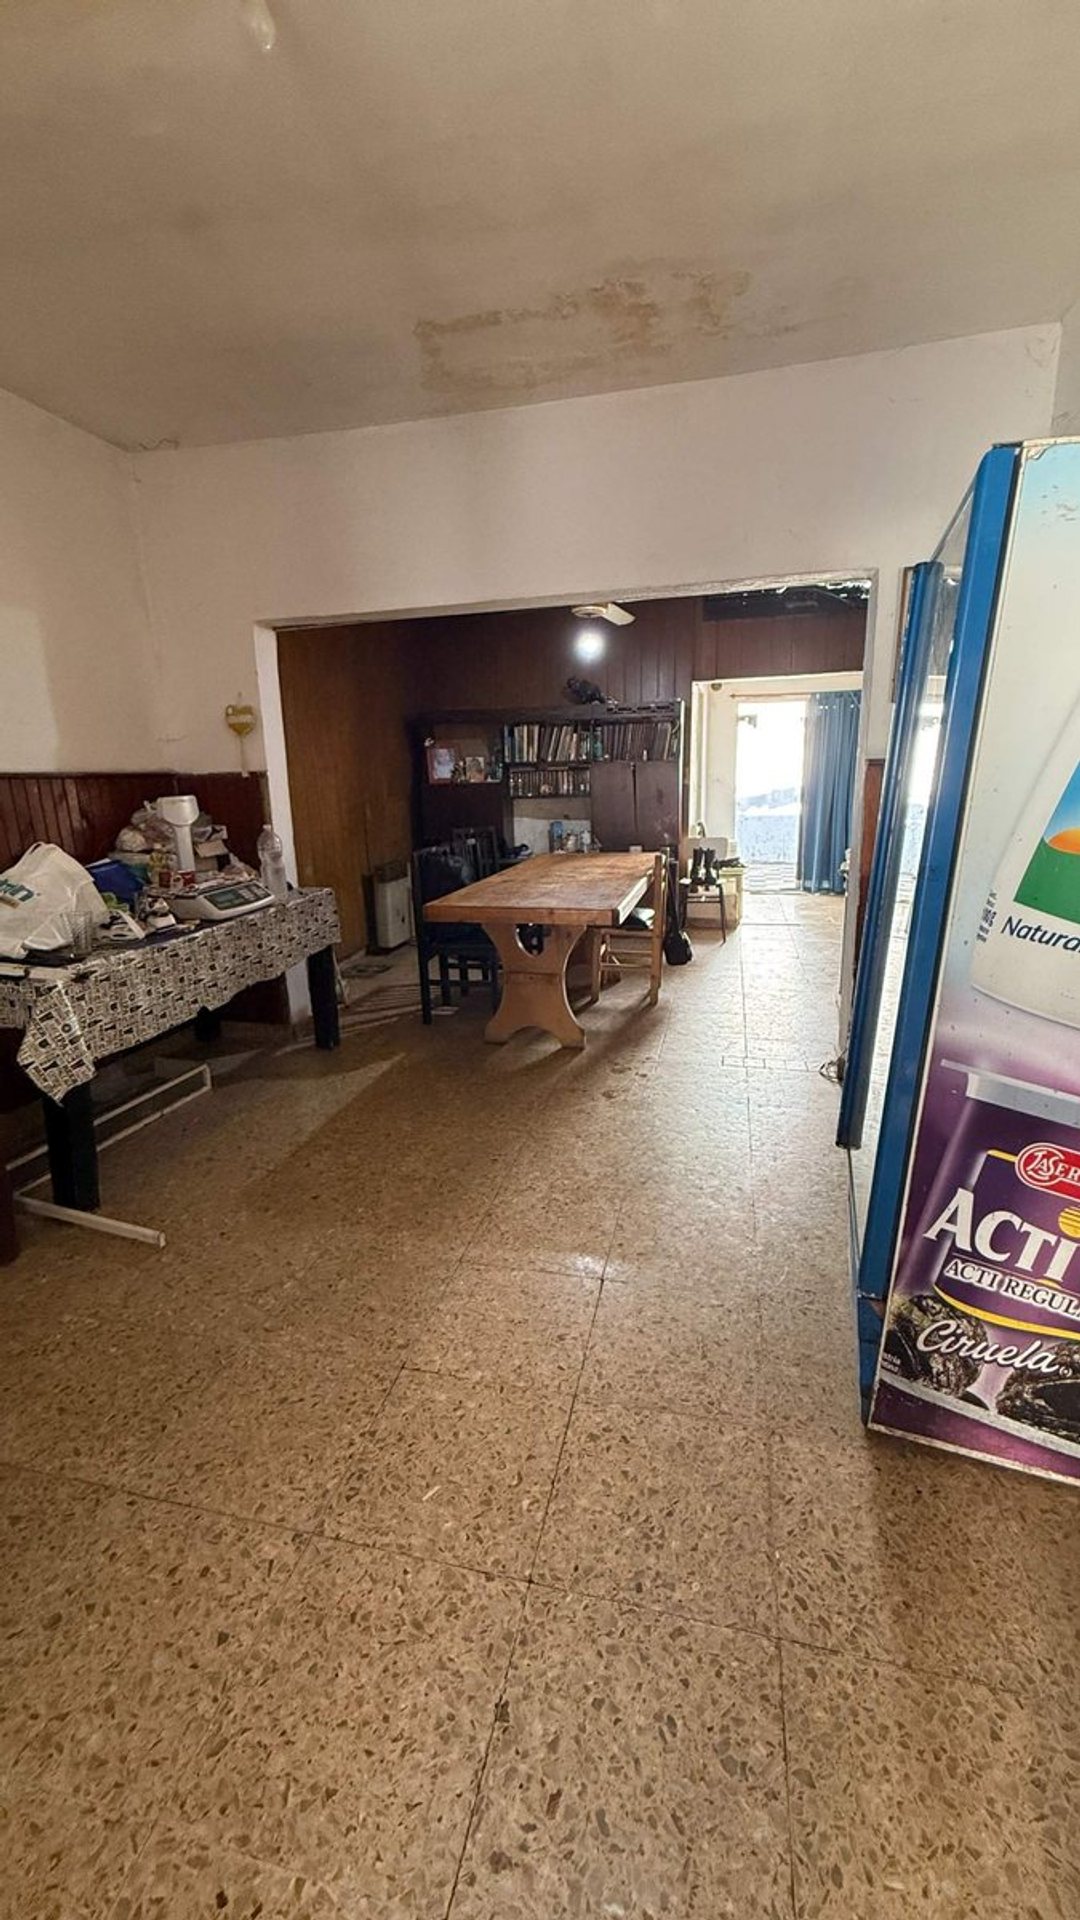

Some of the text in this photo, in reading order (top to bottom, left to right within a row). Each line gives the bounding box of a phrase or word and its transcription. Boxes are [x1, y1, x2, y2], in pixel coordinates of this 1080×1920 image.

[922, 1187, 1080, 1283] ACTI
[945, 1260, 1080, 1318] ACTI REGUL
[916, 1320, 1059, 1373] Ciruela
